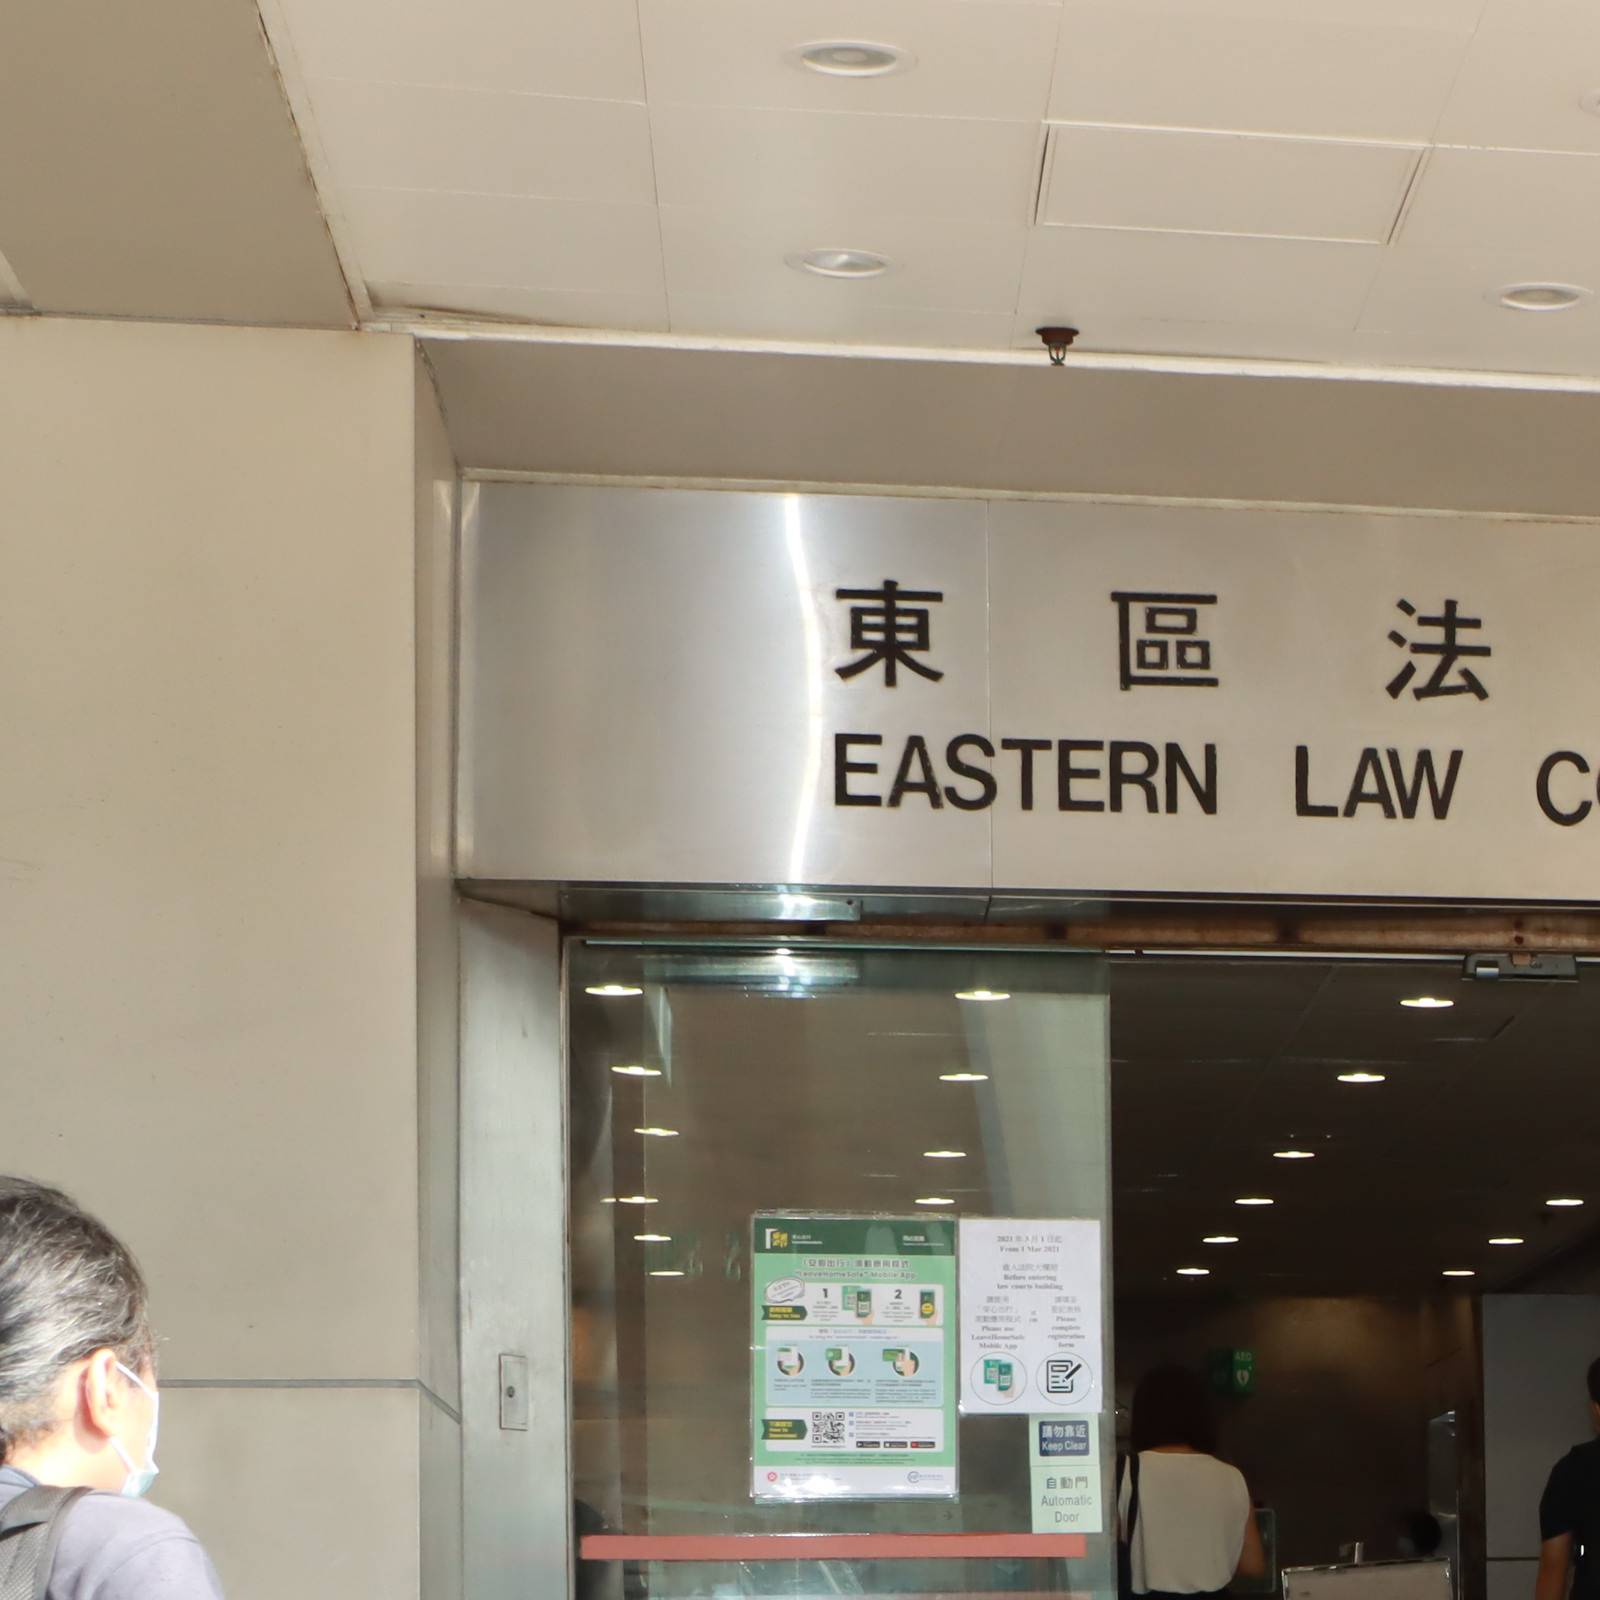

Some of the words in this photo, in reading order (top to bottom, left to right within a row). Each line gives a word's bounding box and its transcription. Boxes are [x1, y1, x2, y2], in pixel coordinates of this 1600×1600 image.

[834, 732, 1218, 816] EASTERN
[1294, 744, 1464, 820] LAW
[822, 1288, 829, 1298] 1
[894, 1289, 902, 1299] 2
[1041, 1424, 1087, 1439] 請勿靠近
[1041, 1441, 1064, 1451] Keep
[1064, 1440, 1087, 1450] Clear
[1046, 1476, 1089, 1489] 自動門
[1041, 1495, 1093, 1507] Automatic
[1054, 1511, 1080, 1523] Door
